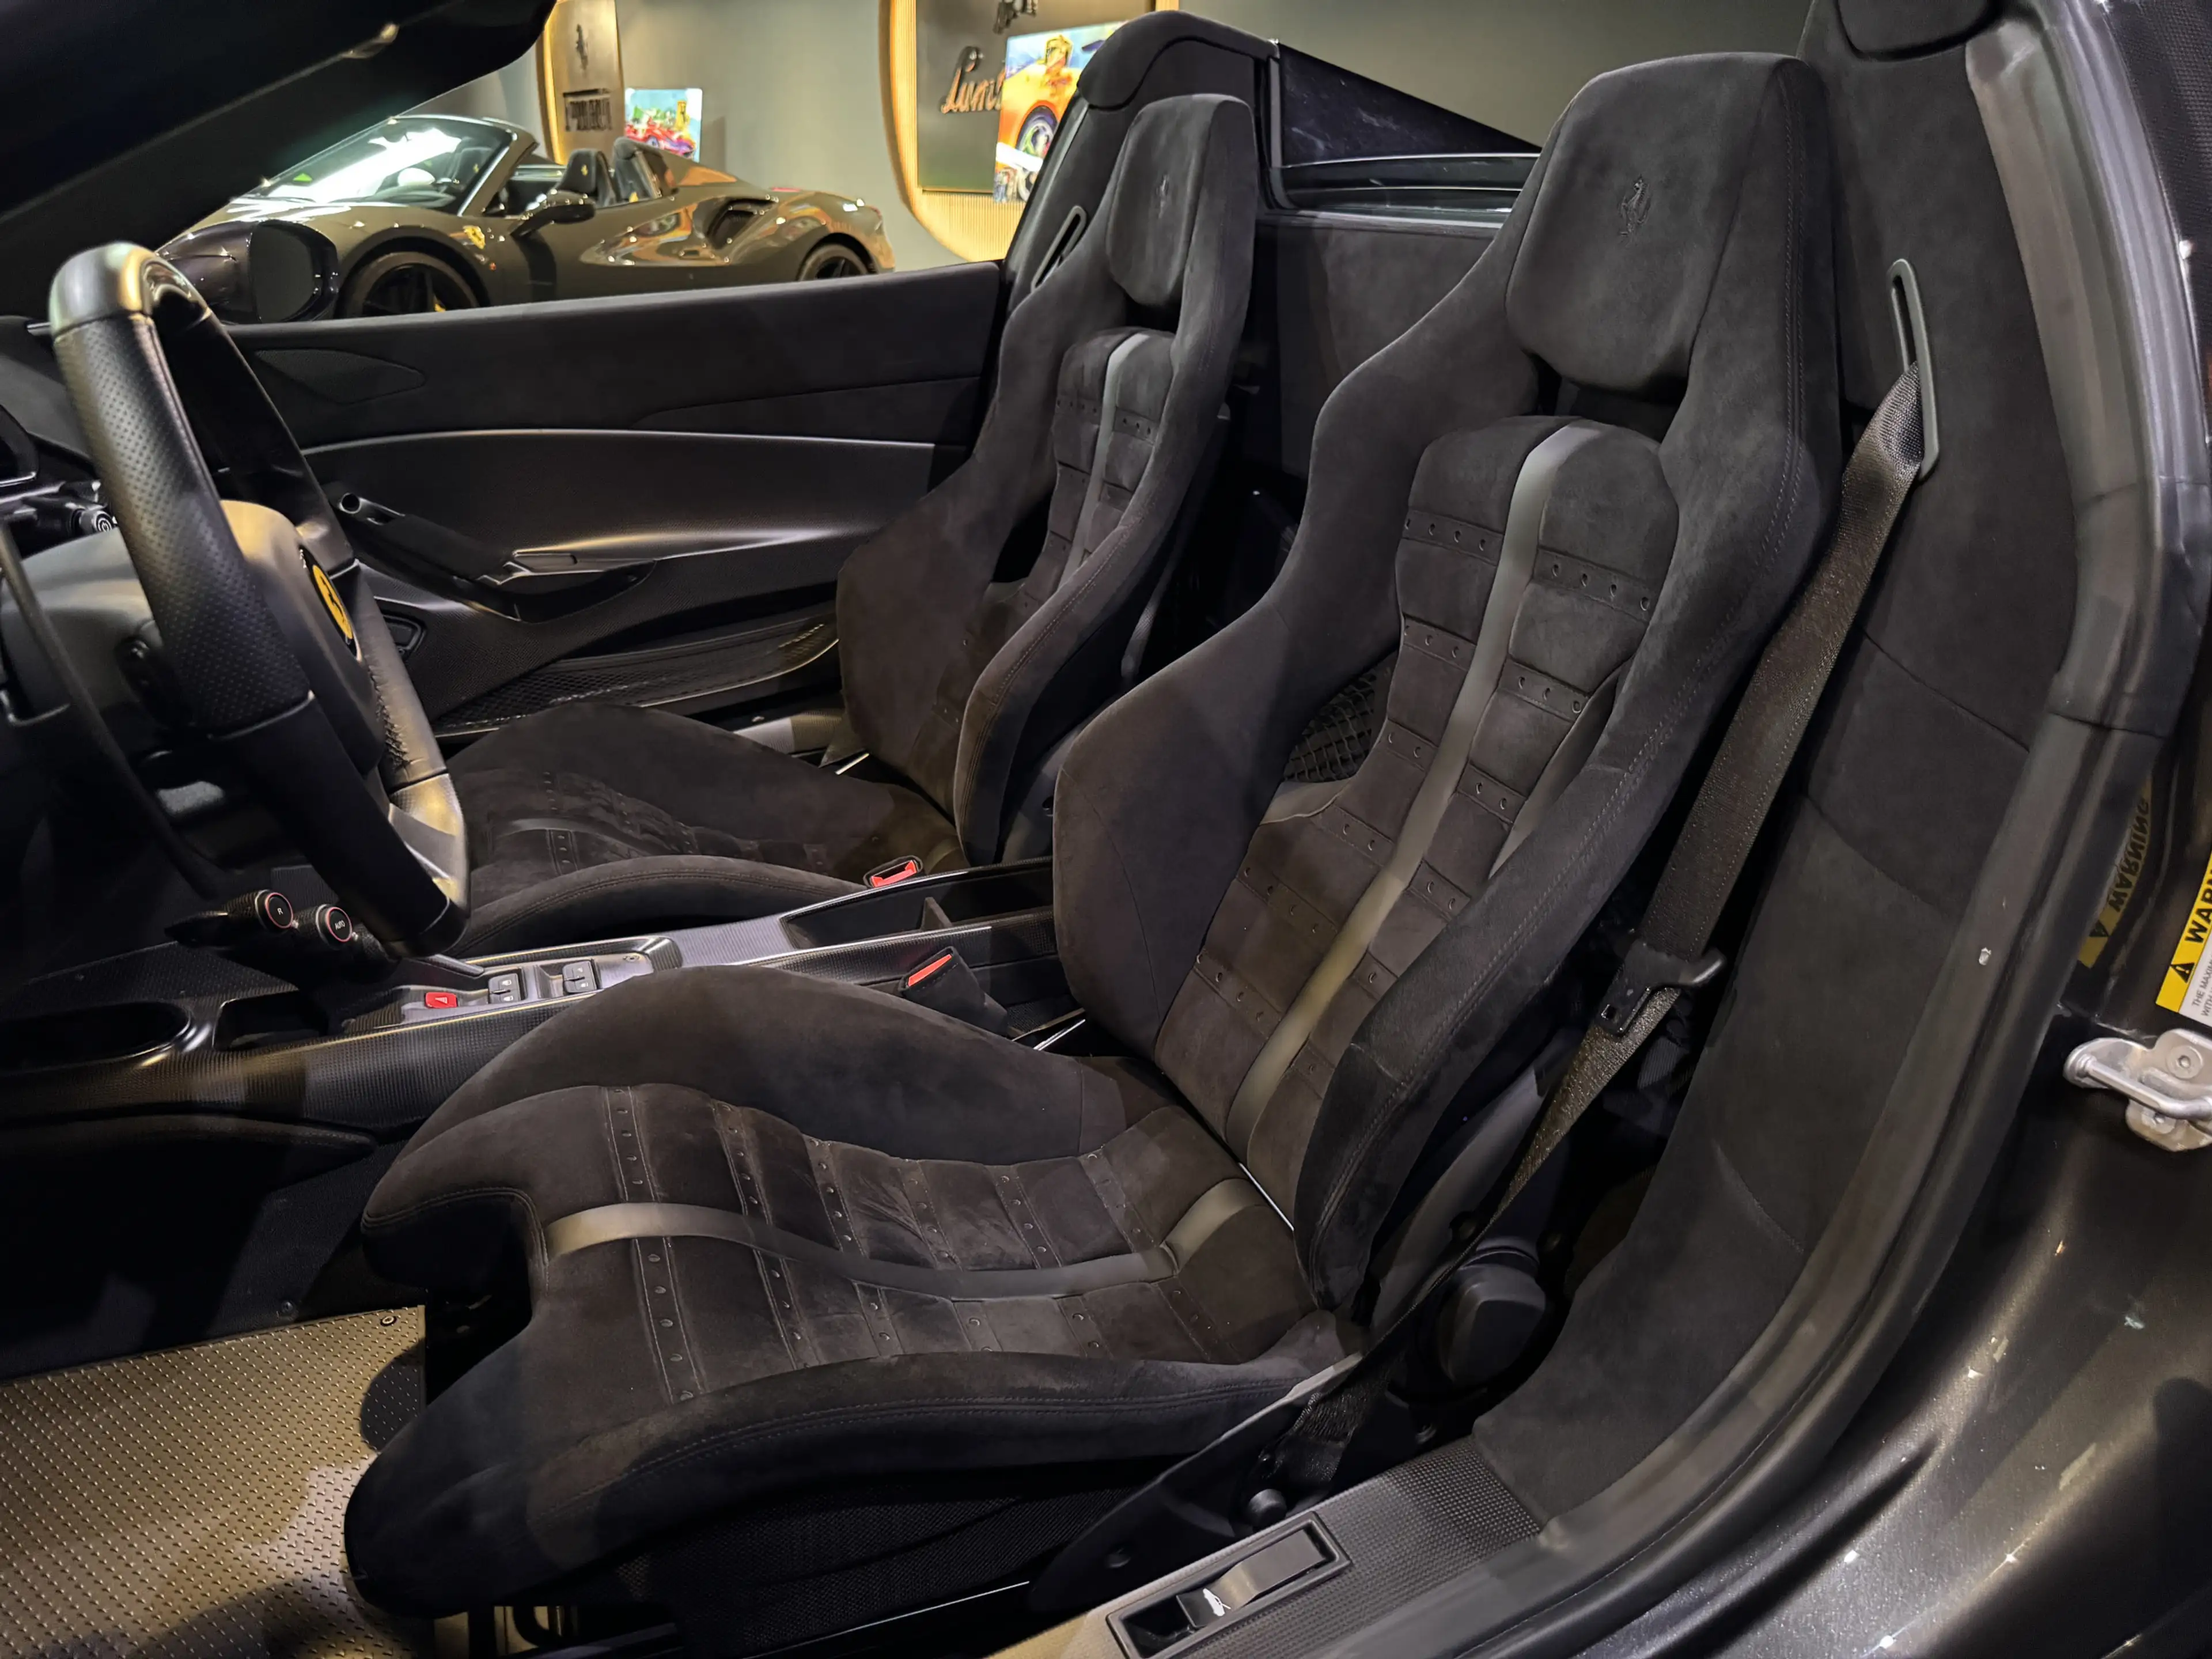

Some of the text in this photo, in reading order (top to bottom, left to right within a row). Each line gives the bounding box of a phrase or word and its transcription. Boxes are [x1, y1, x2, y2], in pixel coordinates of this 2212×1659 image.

[277, 907, 283, 915] R
[335, 919, 346, 930] AUTO
[2191, 990, 2206, 1006] THE
